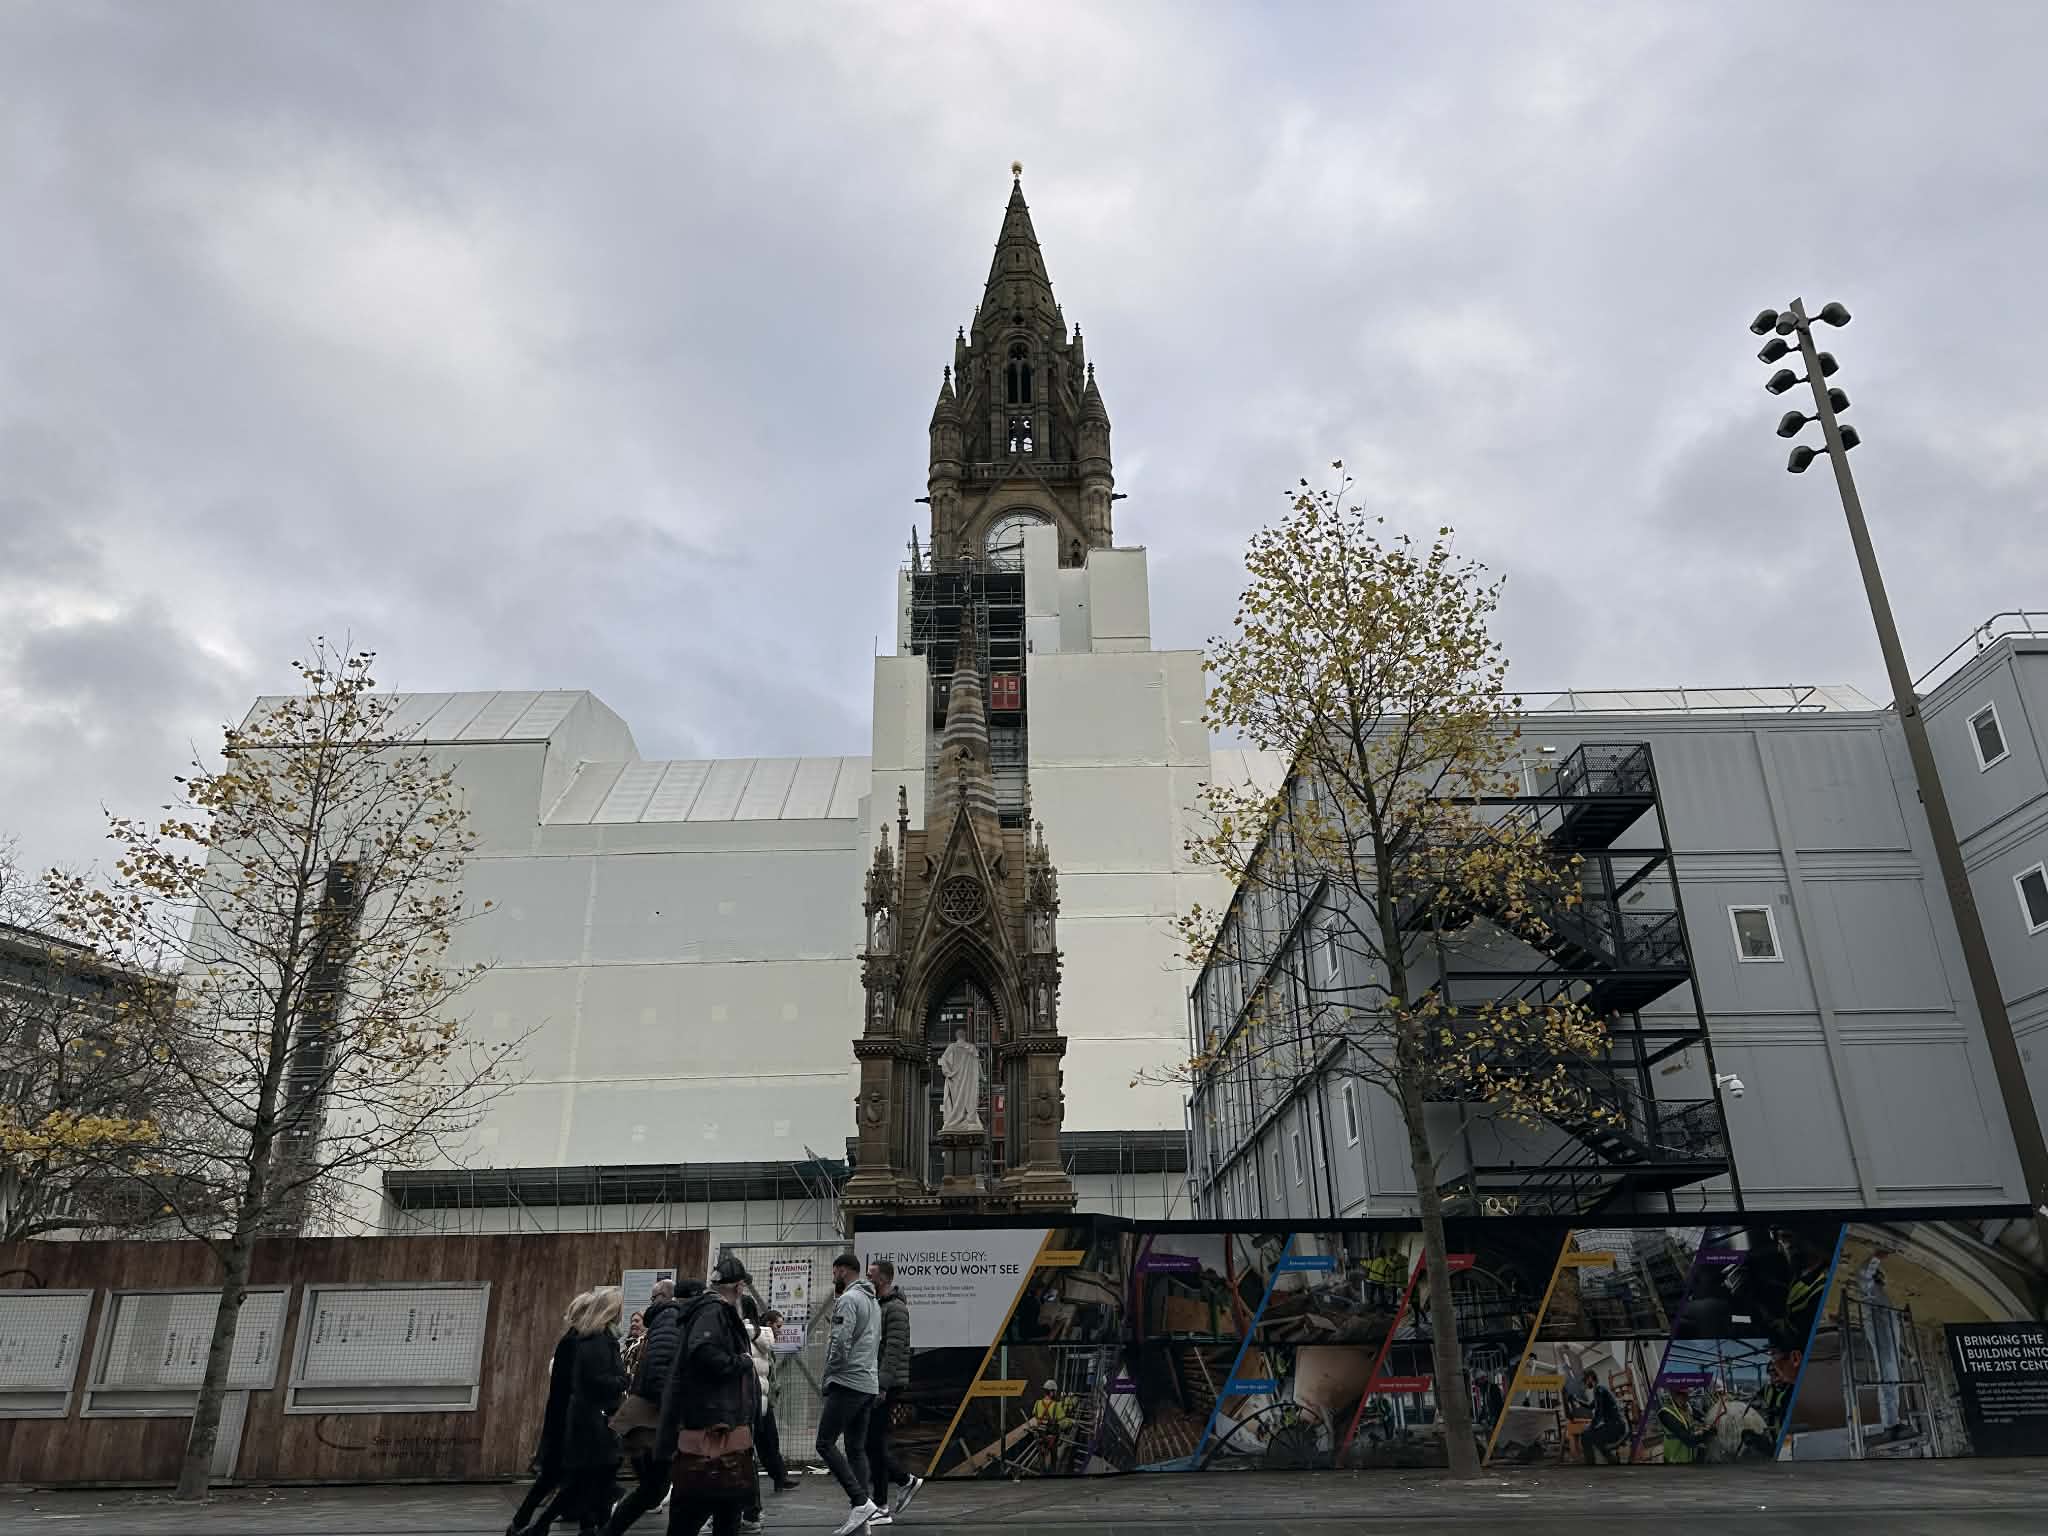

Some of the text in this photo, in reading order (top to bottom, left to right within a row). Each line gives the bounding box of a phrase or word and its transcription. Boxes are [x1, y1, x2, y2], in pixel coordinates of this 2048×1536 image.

[874, 1251, 987, 1263] THE INVISIBLE STORY:
[897, 1264, 1020, 1276] WORK YOU WON'T SEE
[1964, 1334, 2044, 1346] BRINGING THE
[1967, 1346, 2048, 1359] BUILDING INTO
[1969, 1361, 1993, 1372] THE
[1994, 1360, 2017, 1372] 21ST
